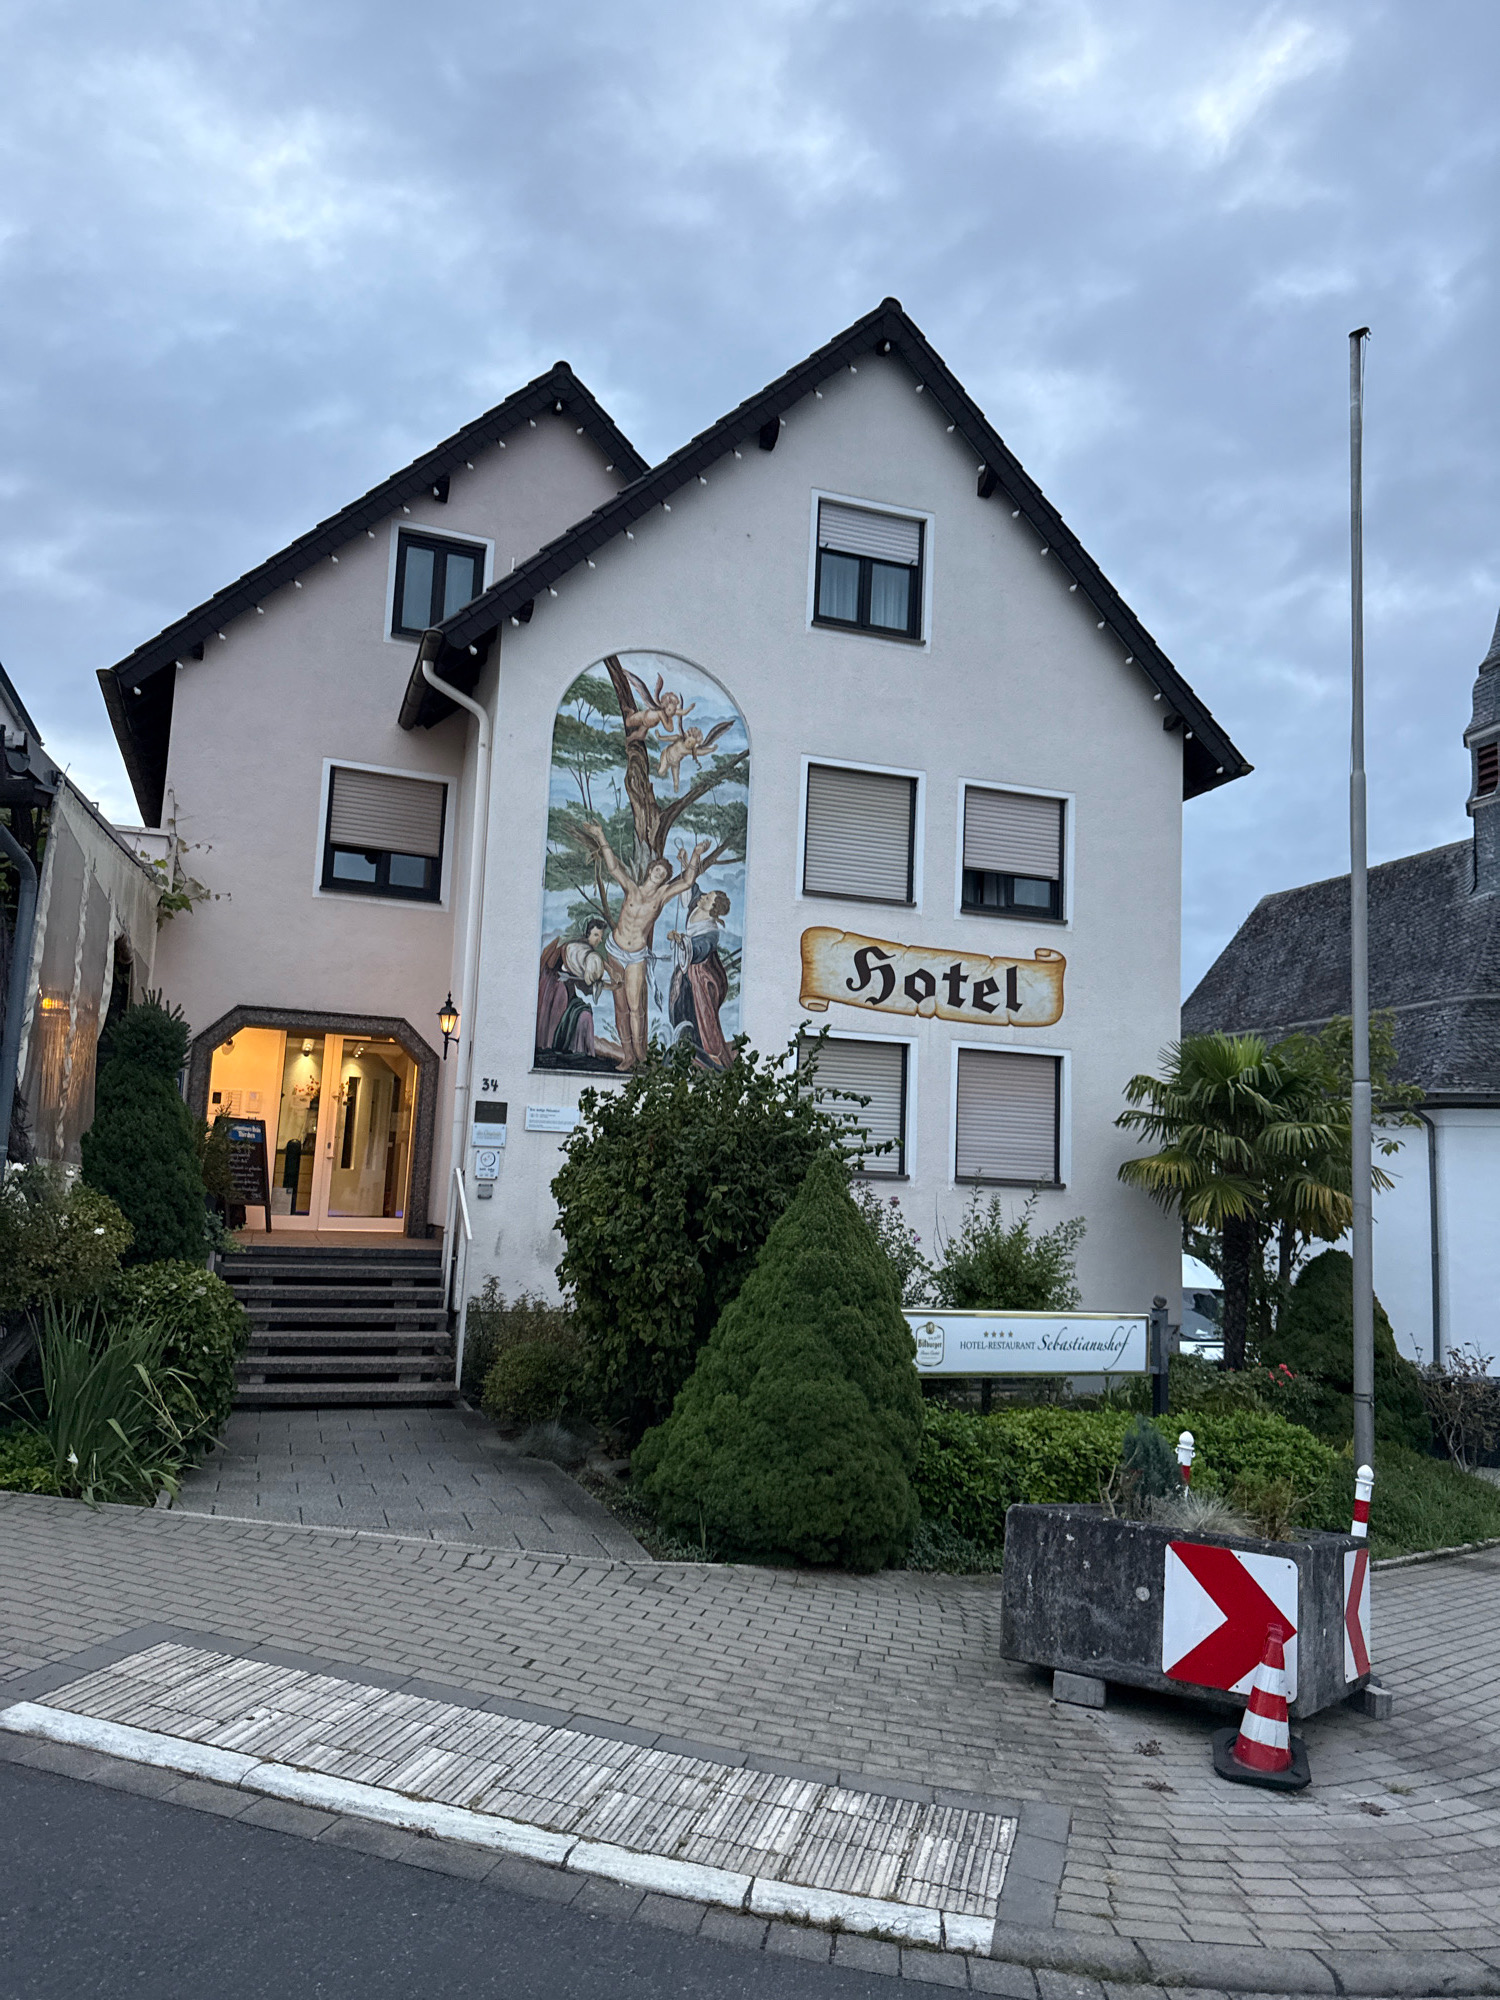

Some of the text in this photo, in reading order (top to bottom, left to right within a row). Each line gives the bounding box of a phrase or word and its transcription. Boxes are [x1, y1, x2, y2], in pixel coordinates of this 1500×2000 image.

[846, 946, 1023, 1014] Hotel
[482, 1078, 498, 1092] 34
[959, 1324, 1138, 1371] HOTEL-RESTAURANT Sebastianushof
